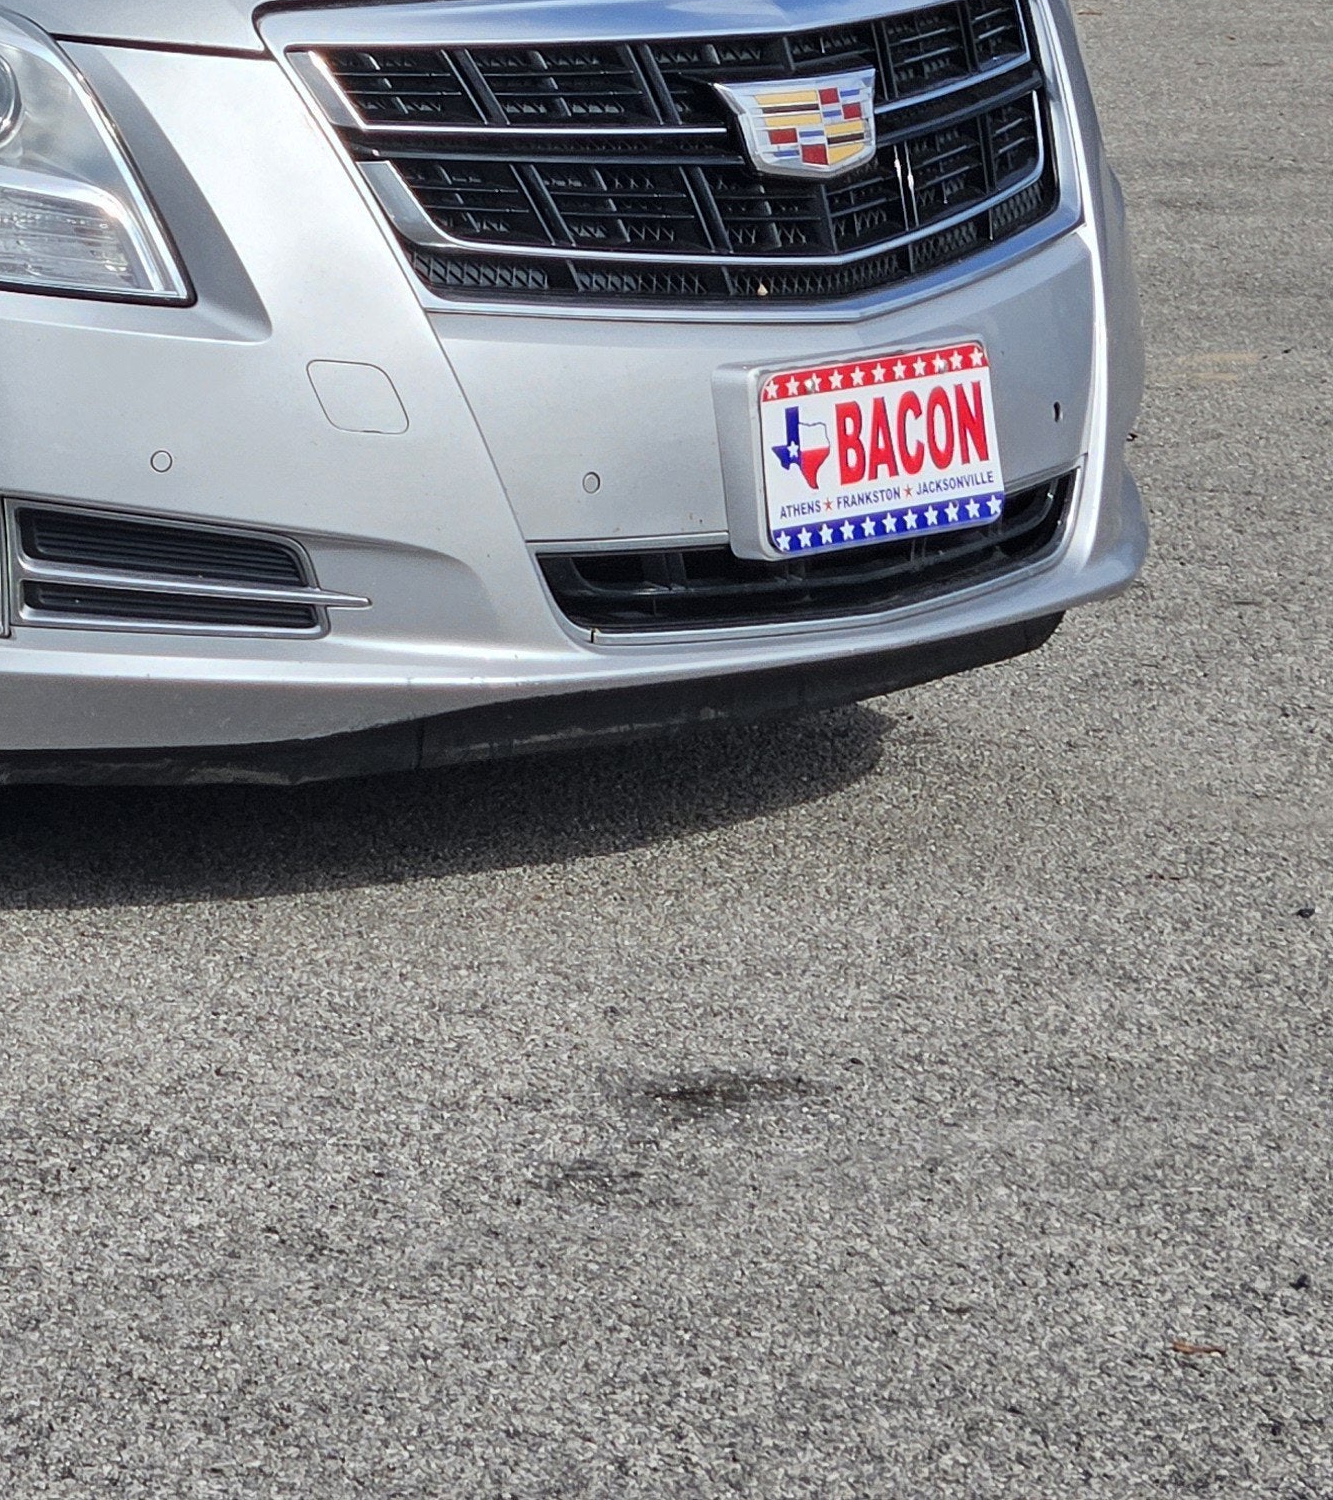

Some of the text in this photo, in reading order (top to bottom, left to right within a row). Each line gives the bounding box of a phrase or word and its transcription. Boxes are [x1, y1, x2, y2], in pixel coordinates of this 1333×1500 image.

[835, 380, 990, 486] BACON
[780, 470, 994, 519] ATHENS FRANKSTON JACKSONVILLE
